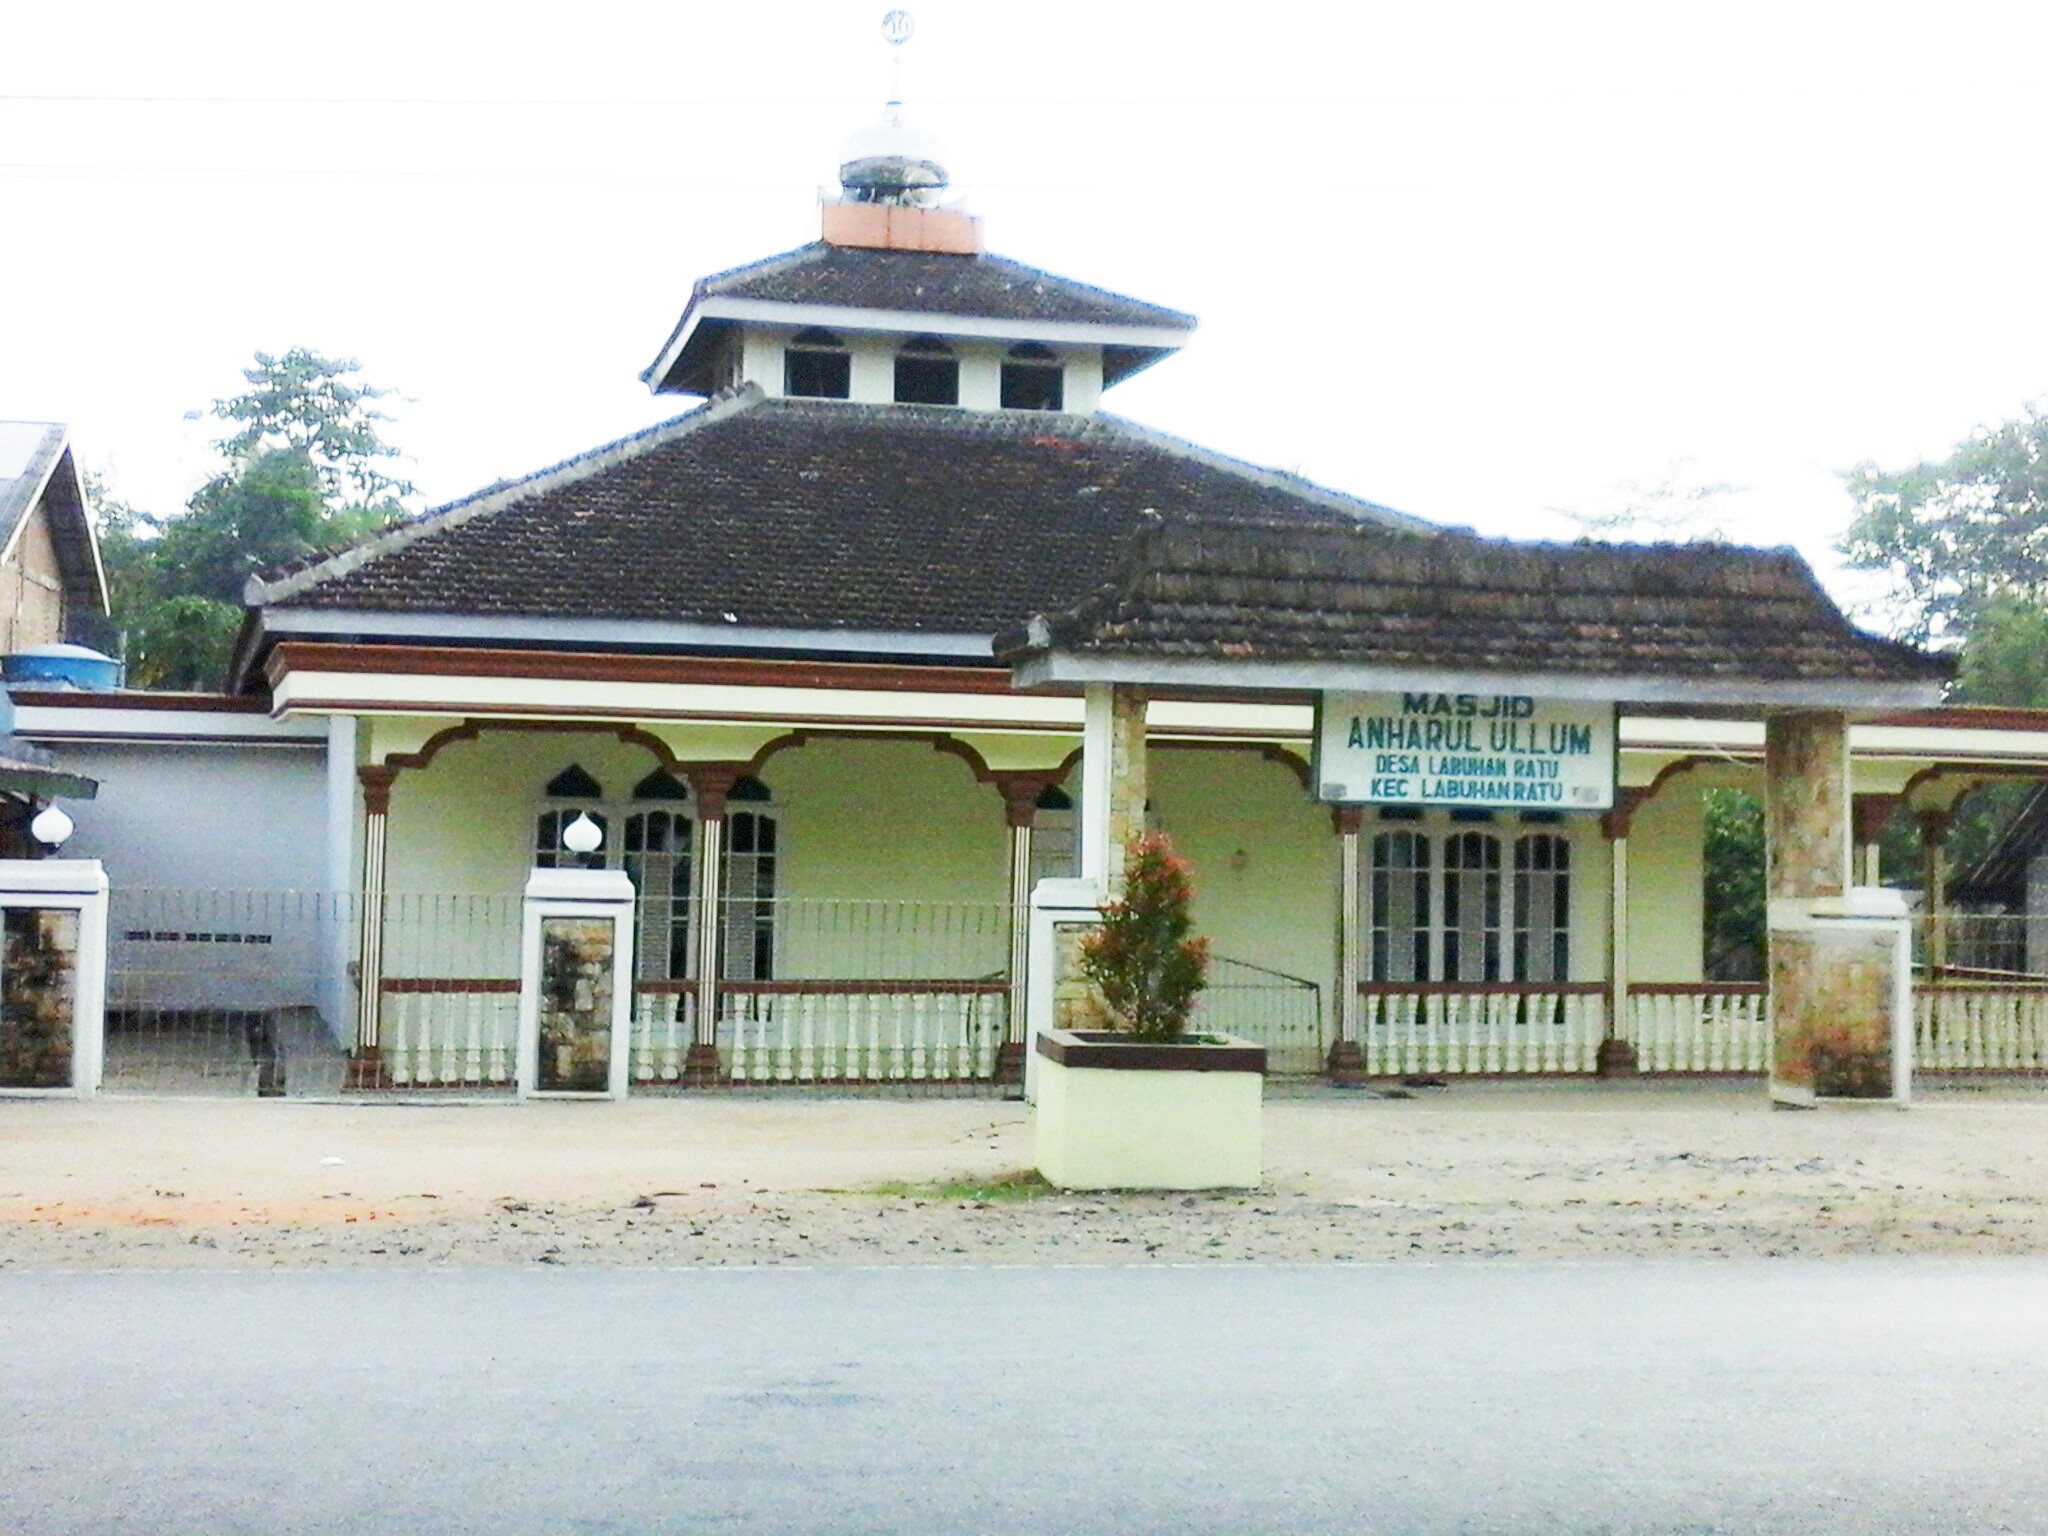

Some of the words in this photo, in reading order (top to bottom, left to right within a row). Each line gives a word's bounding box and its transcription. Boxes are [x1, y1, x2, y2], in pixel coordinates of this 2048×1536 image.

[1403, 692, 1534, 718] MASJID
[1348, 715, 1481, 752] ANHARUL
[1489, 720, 1592, 755] ULLUM
[1376, 754, 1420, 774] DESA
[1429, 756, 1506, 777] LABUHAN
[1514, 758, 1559, 779] RATU
[1371, 778, 1409, 798] KEC
